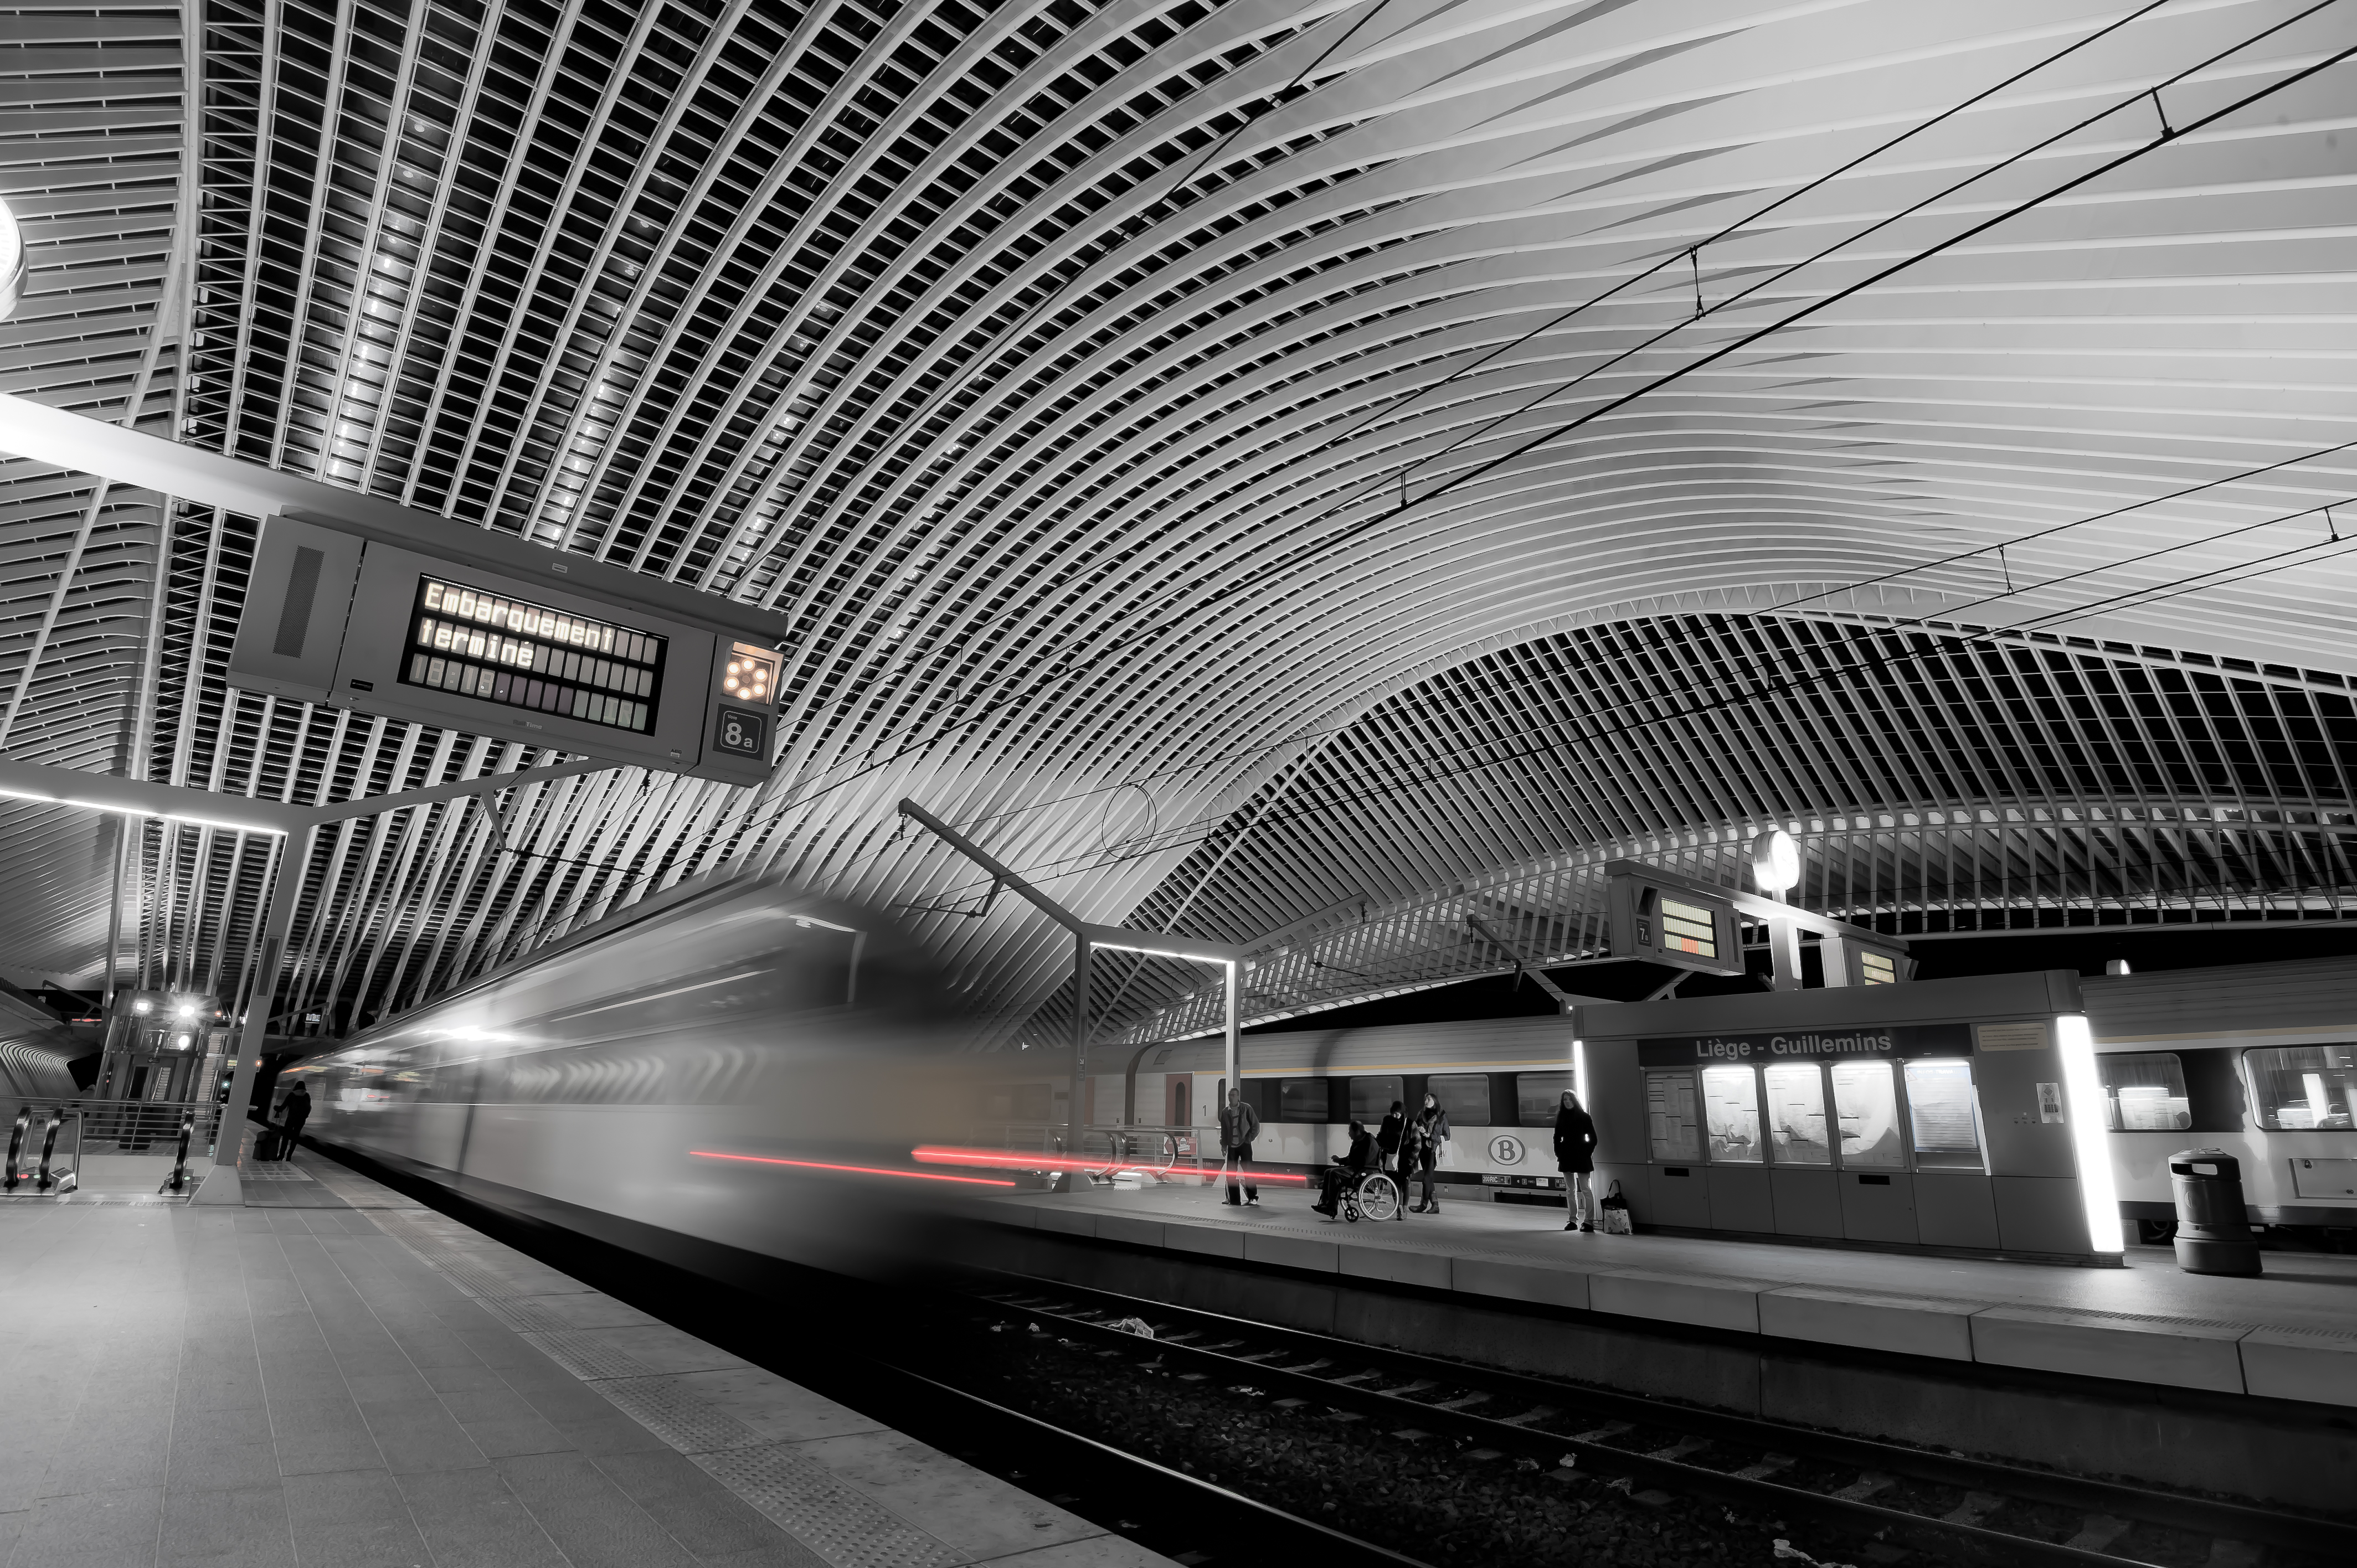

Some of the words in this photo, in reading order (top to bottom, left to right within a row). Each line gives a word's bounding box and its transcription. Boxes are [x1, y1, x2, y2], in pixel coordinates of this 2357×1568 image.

[425, 582, 611, 649] Embarquement
[422, 619, 534, 667] terminé
[1696, 1039, 1751, 1060] Liège
[1771, 1033, 1891, 1055] Guillemins
[1202, 1105, 1207, 1116] 1
[1497, 1140, 1515, 1160] B
